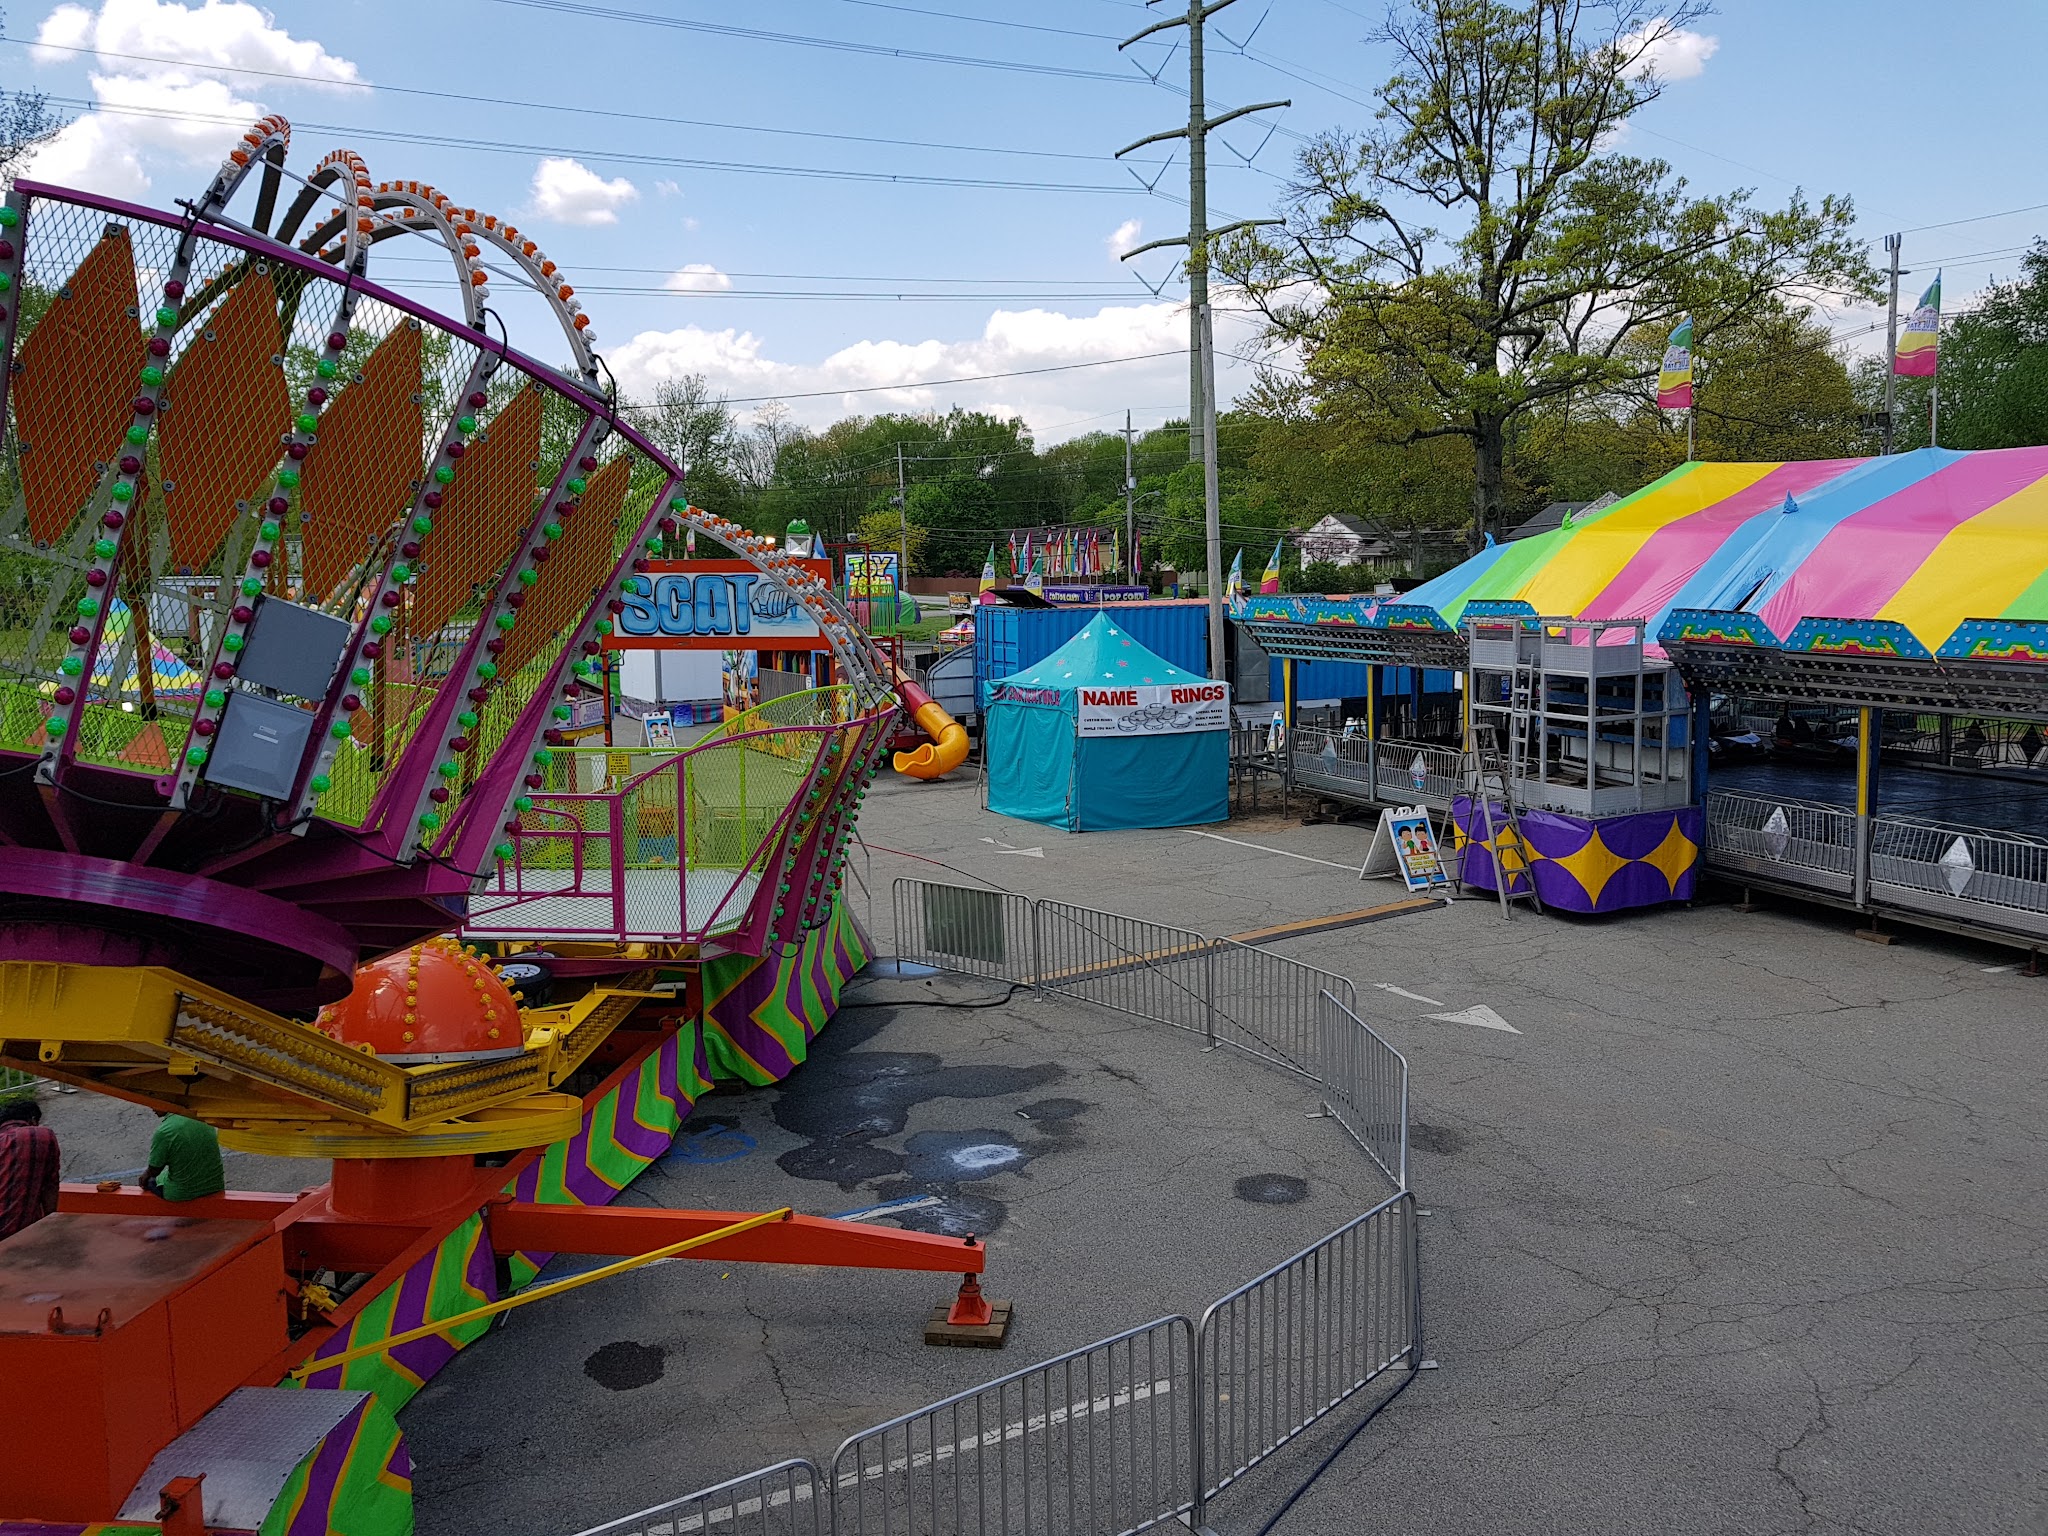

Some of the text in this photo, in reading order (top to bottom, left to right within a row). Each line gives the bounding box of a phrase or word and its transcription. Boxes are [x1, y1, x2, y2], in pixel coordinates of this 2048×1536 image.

[848, 555, 894, 578] TOY
[619, 574, 759, 636] SCAT
[1104, 593, 1122, 601] POP
[1083, 685, 1225, 706] NAME RINGS
